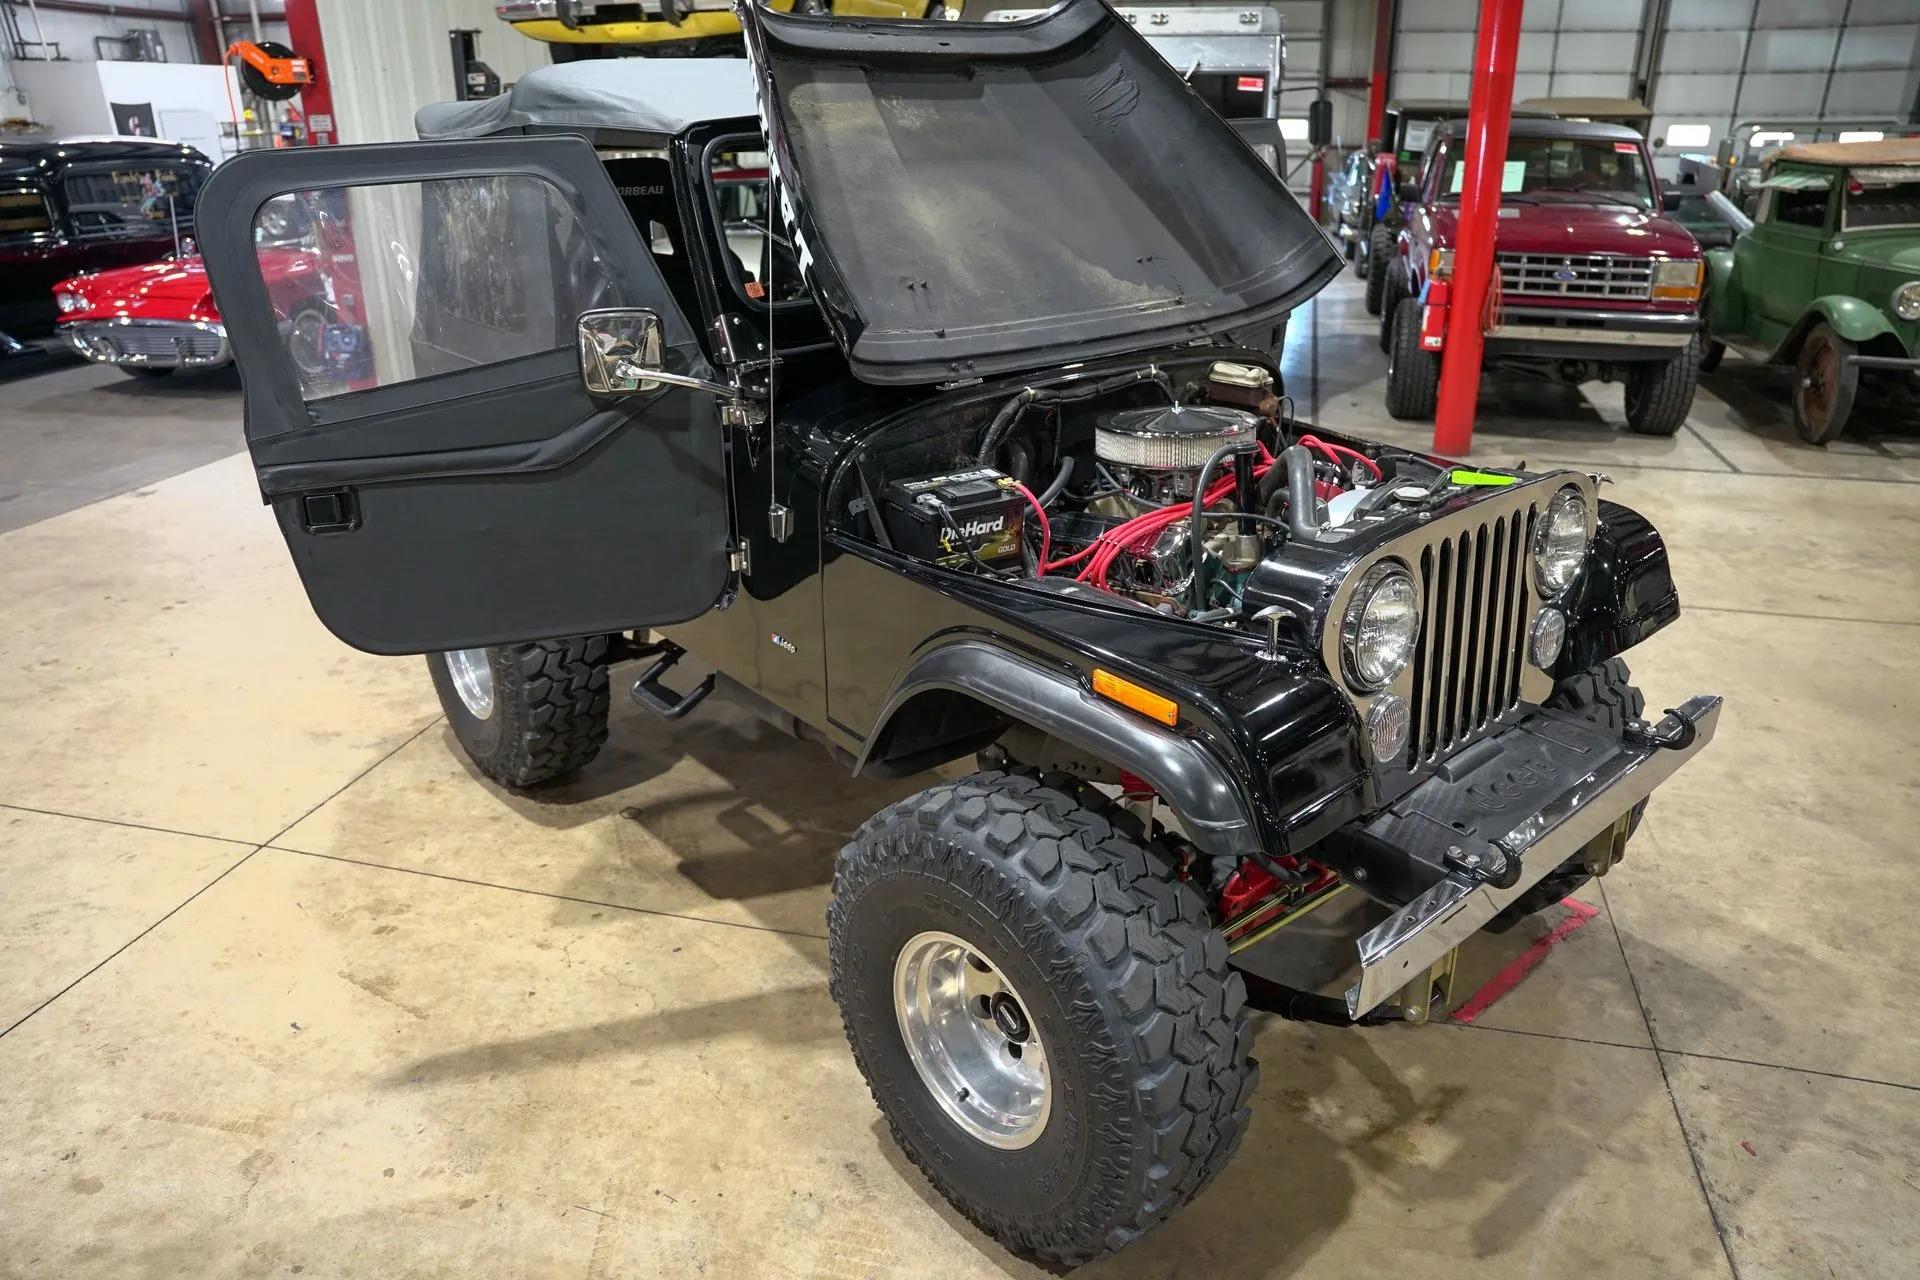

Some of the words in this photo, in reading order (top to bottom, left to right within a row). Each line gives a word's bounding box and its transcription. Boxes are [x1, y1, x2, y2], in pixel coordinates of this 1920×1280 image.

[617, 185, 664, 197] ORBEAU
[997, 544, 1016, 553] GOLD
[1466, 759, 1557, 812] Jeep
